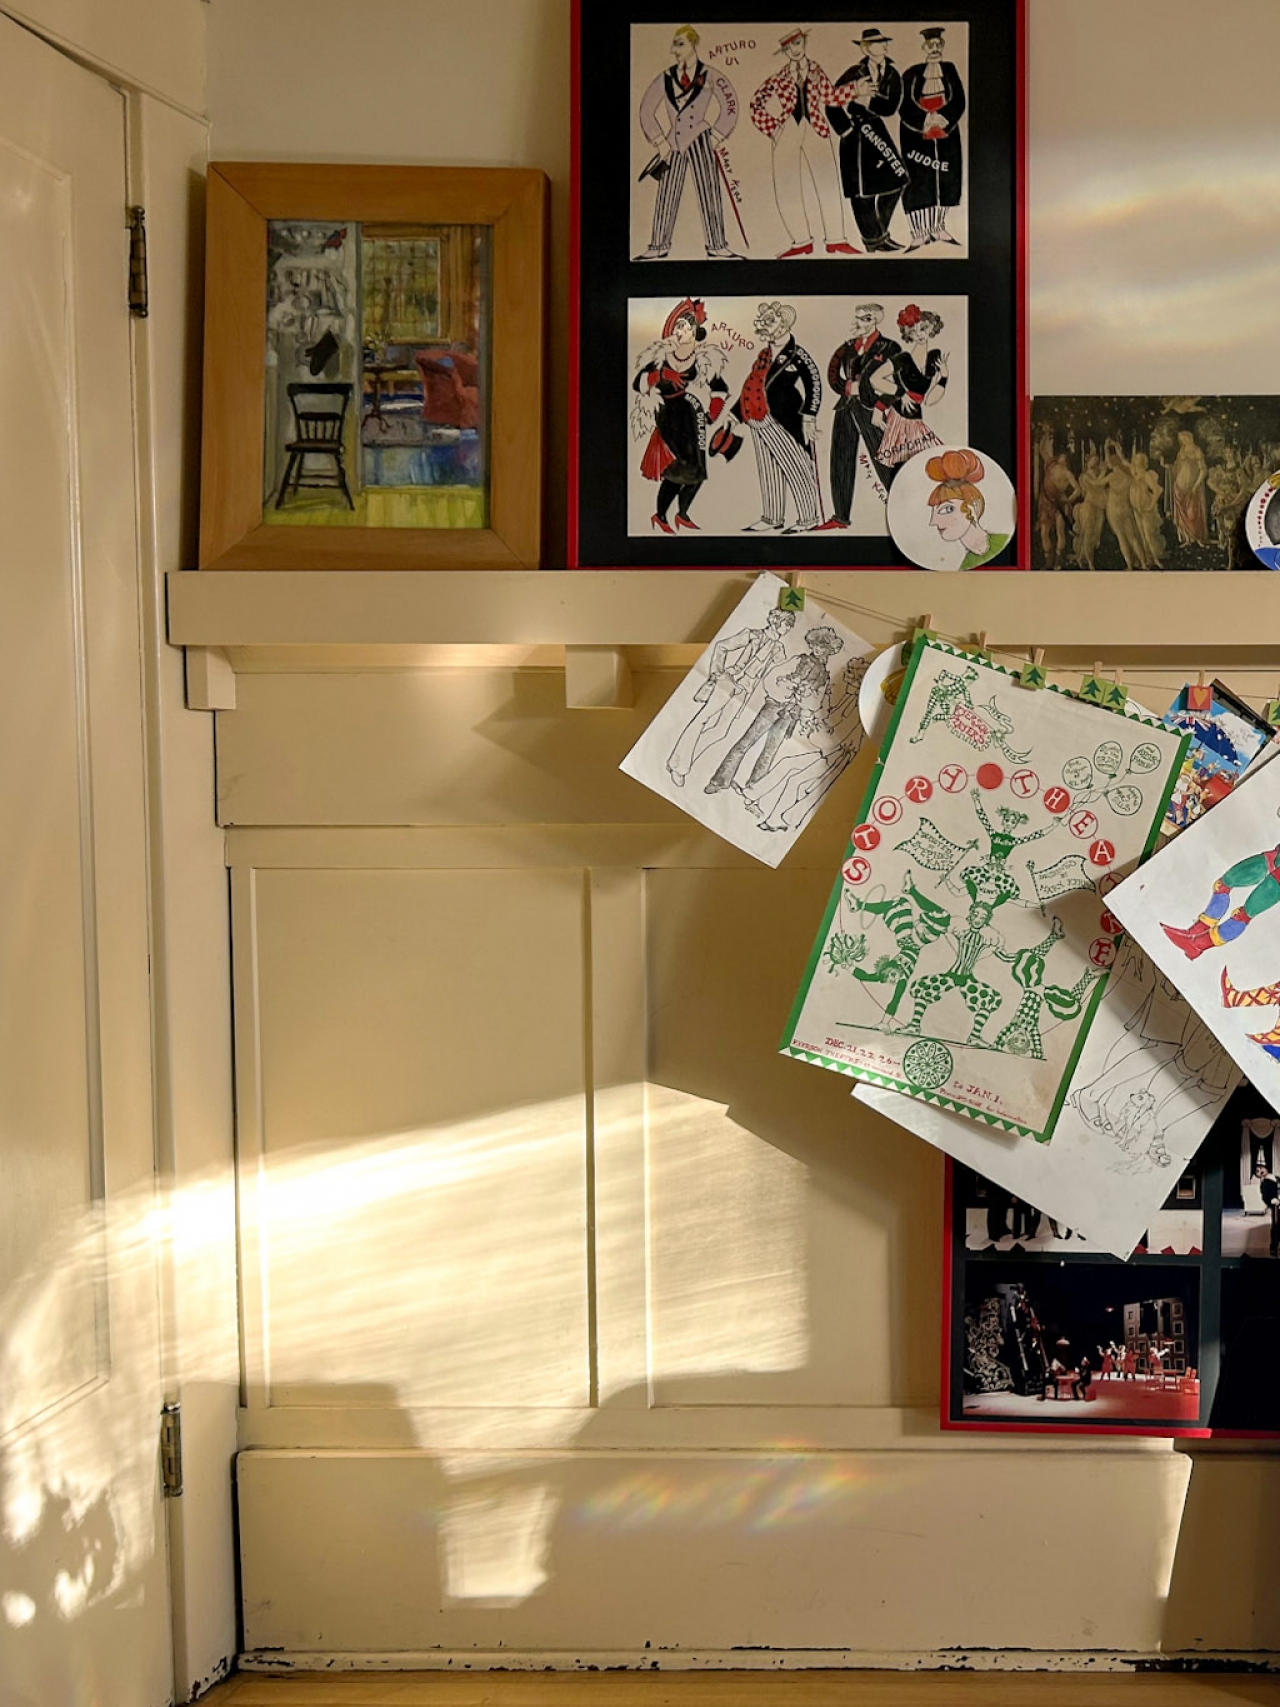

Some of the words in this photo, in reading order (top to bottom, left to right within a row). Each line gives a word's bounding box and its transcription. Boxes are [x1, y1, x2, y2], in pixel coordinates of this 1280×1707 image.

[709, 39, 756, 60] ARTURO
[715, 77, 736, 116] CLARK
[861, 123, 906, 177] GANGSTER
[906, 149, 950, 172] JUDGE
[711, 321, 755, 351] ARTURO
[844, 767, 964, 882] STORY
